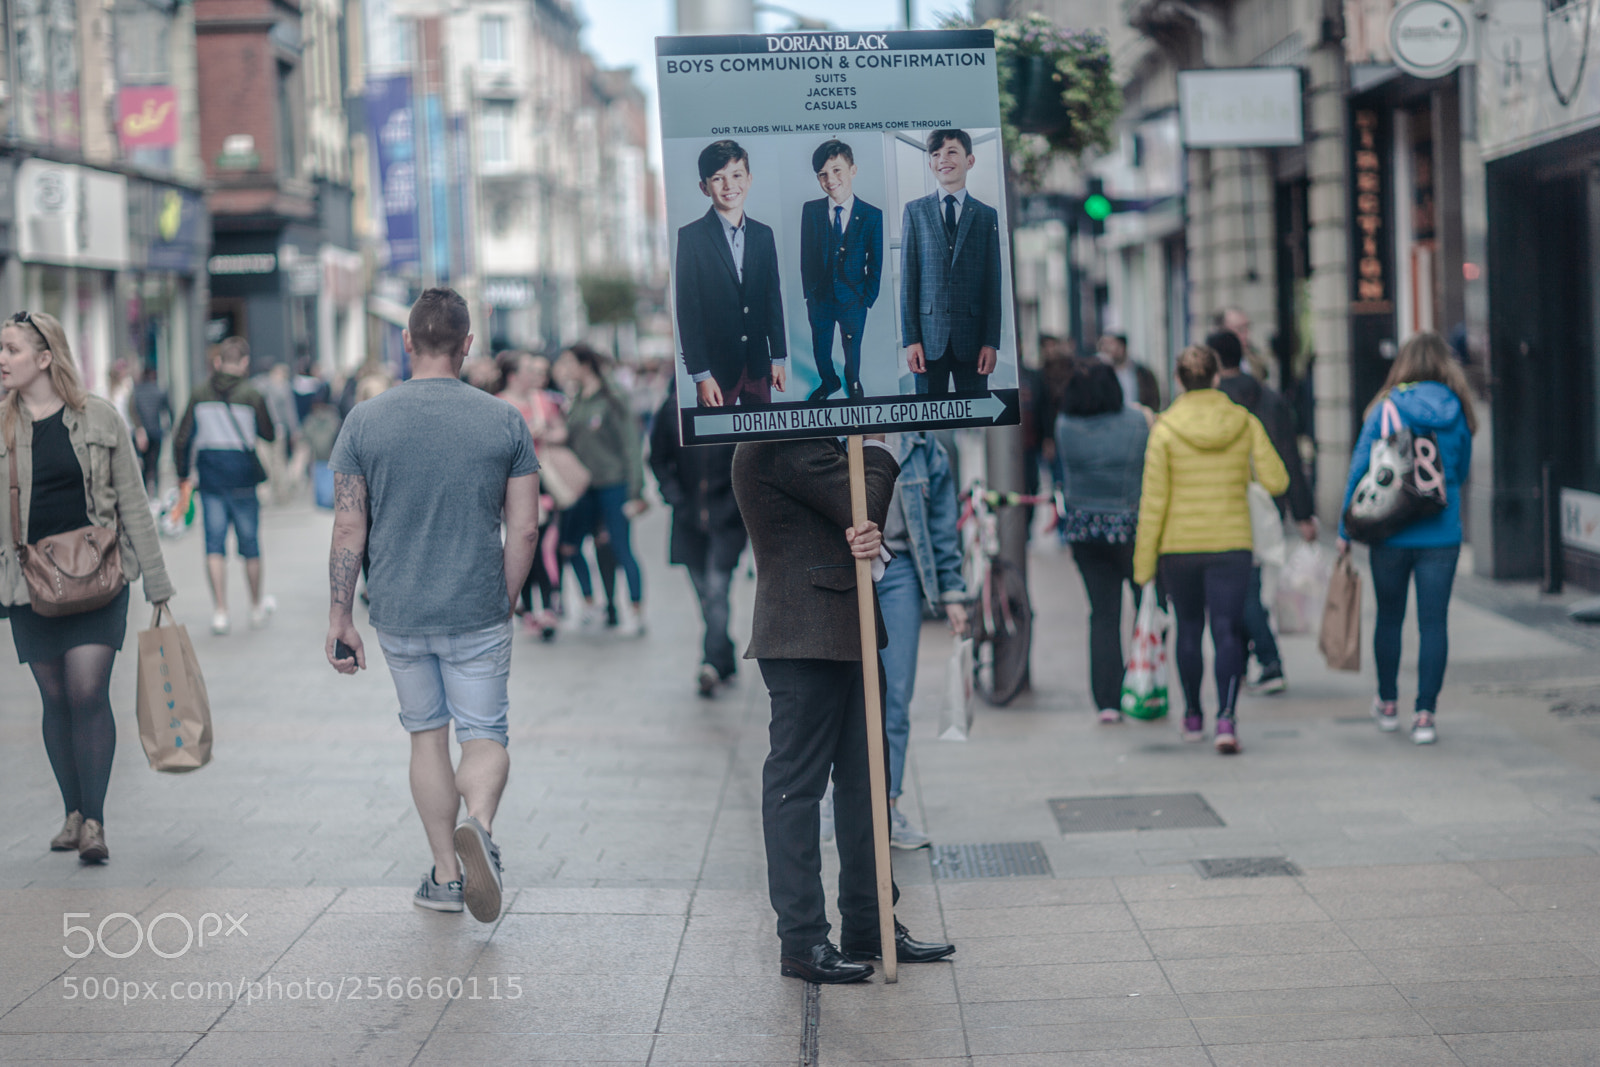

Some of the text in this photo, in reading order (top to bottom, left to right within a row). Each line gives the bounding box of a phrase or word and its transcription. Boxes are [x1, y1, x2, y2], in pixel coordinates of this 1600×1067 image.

[667, 52, 986, 74] BOYS COMMUNION & CONFIRMATION
[815, 73, 847, 83] SUITS
[806, 86, 857, 97] JACKETS
[804, 100, 858, 111] CASUALS
[711, 119, 952, 135] OUR TAILORS WILL MAKE YOUR DREAMS COME THROUGH
[732, 400, 973, 432] DORIAN BLACK, UNIT 2, GPO ARCADE
